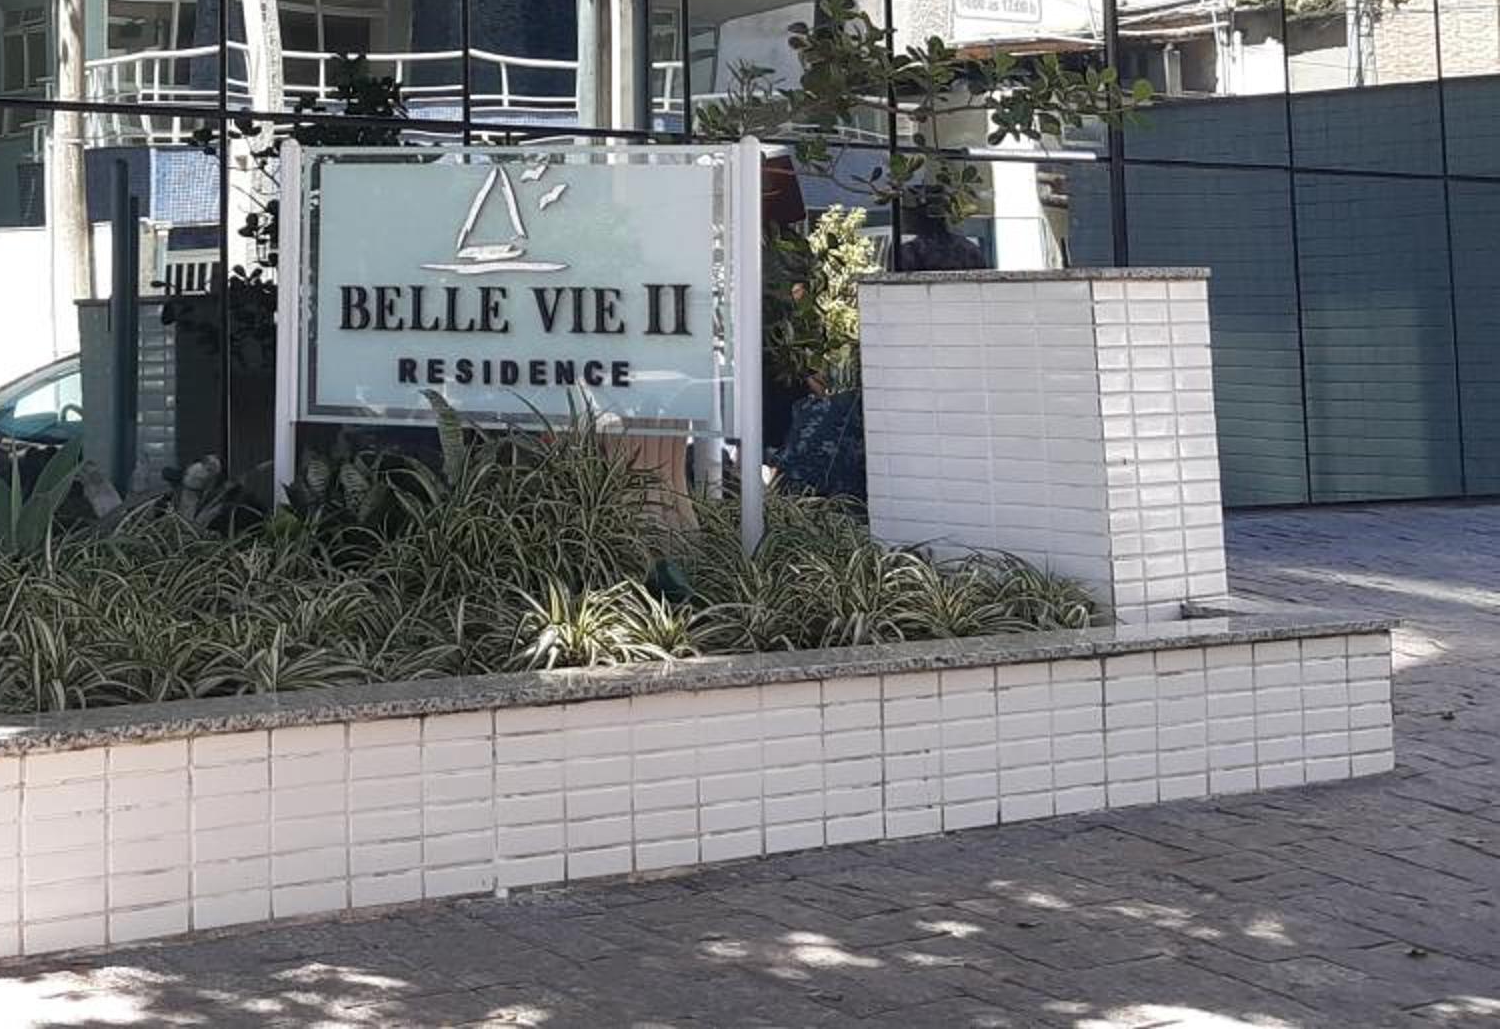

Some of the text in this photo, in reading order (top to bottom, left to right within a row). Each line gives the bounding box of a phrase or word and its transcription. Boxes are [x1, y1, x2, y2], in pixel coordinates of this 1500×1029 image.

[338, 283, 693, 336] BELLE VIE II
[396, 357, 632, 388] RESIDENCE
